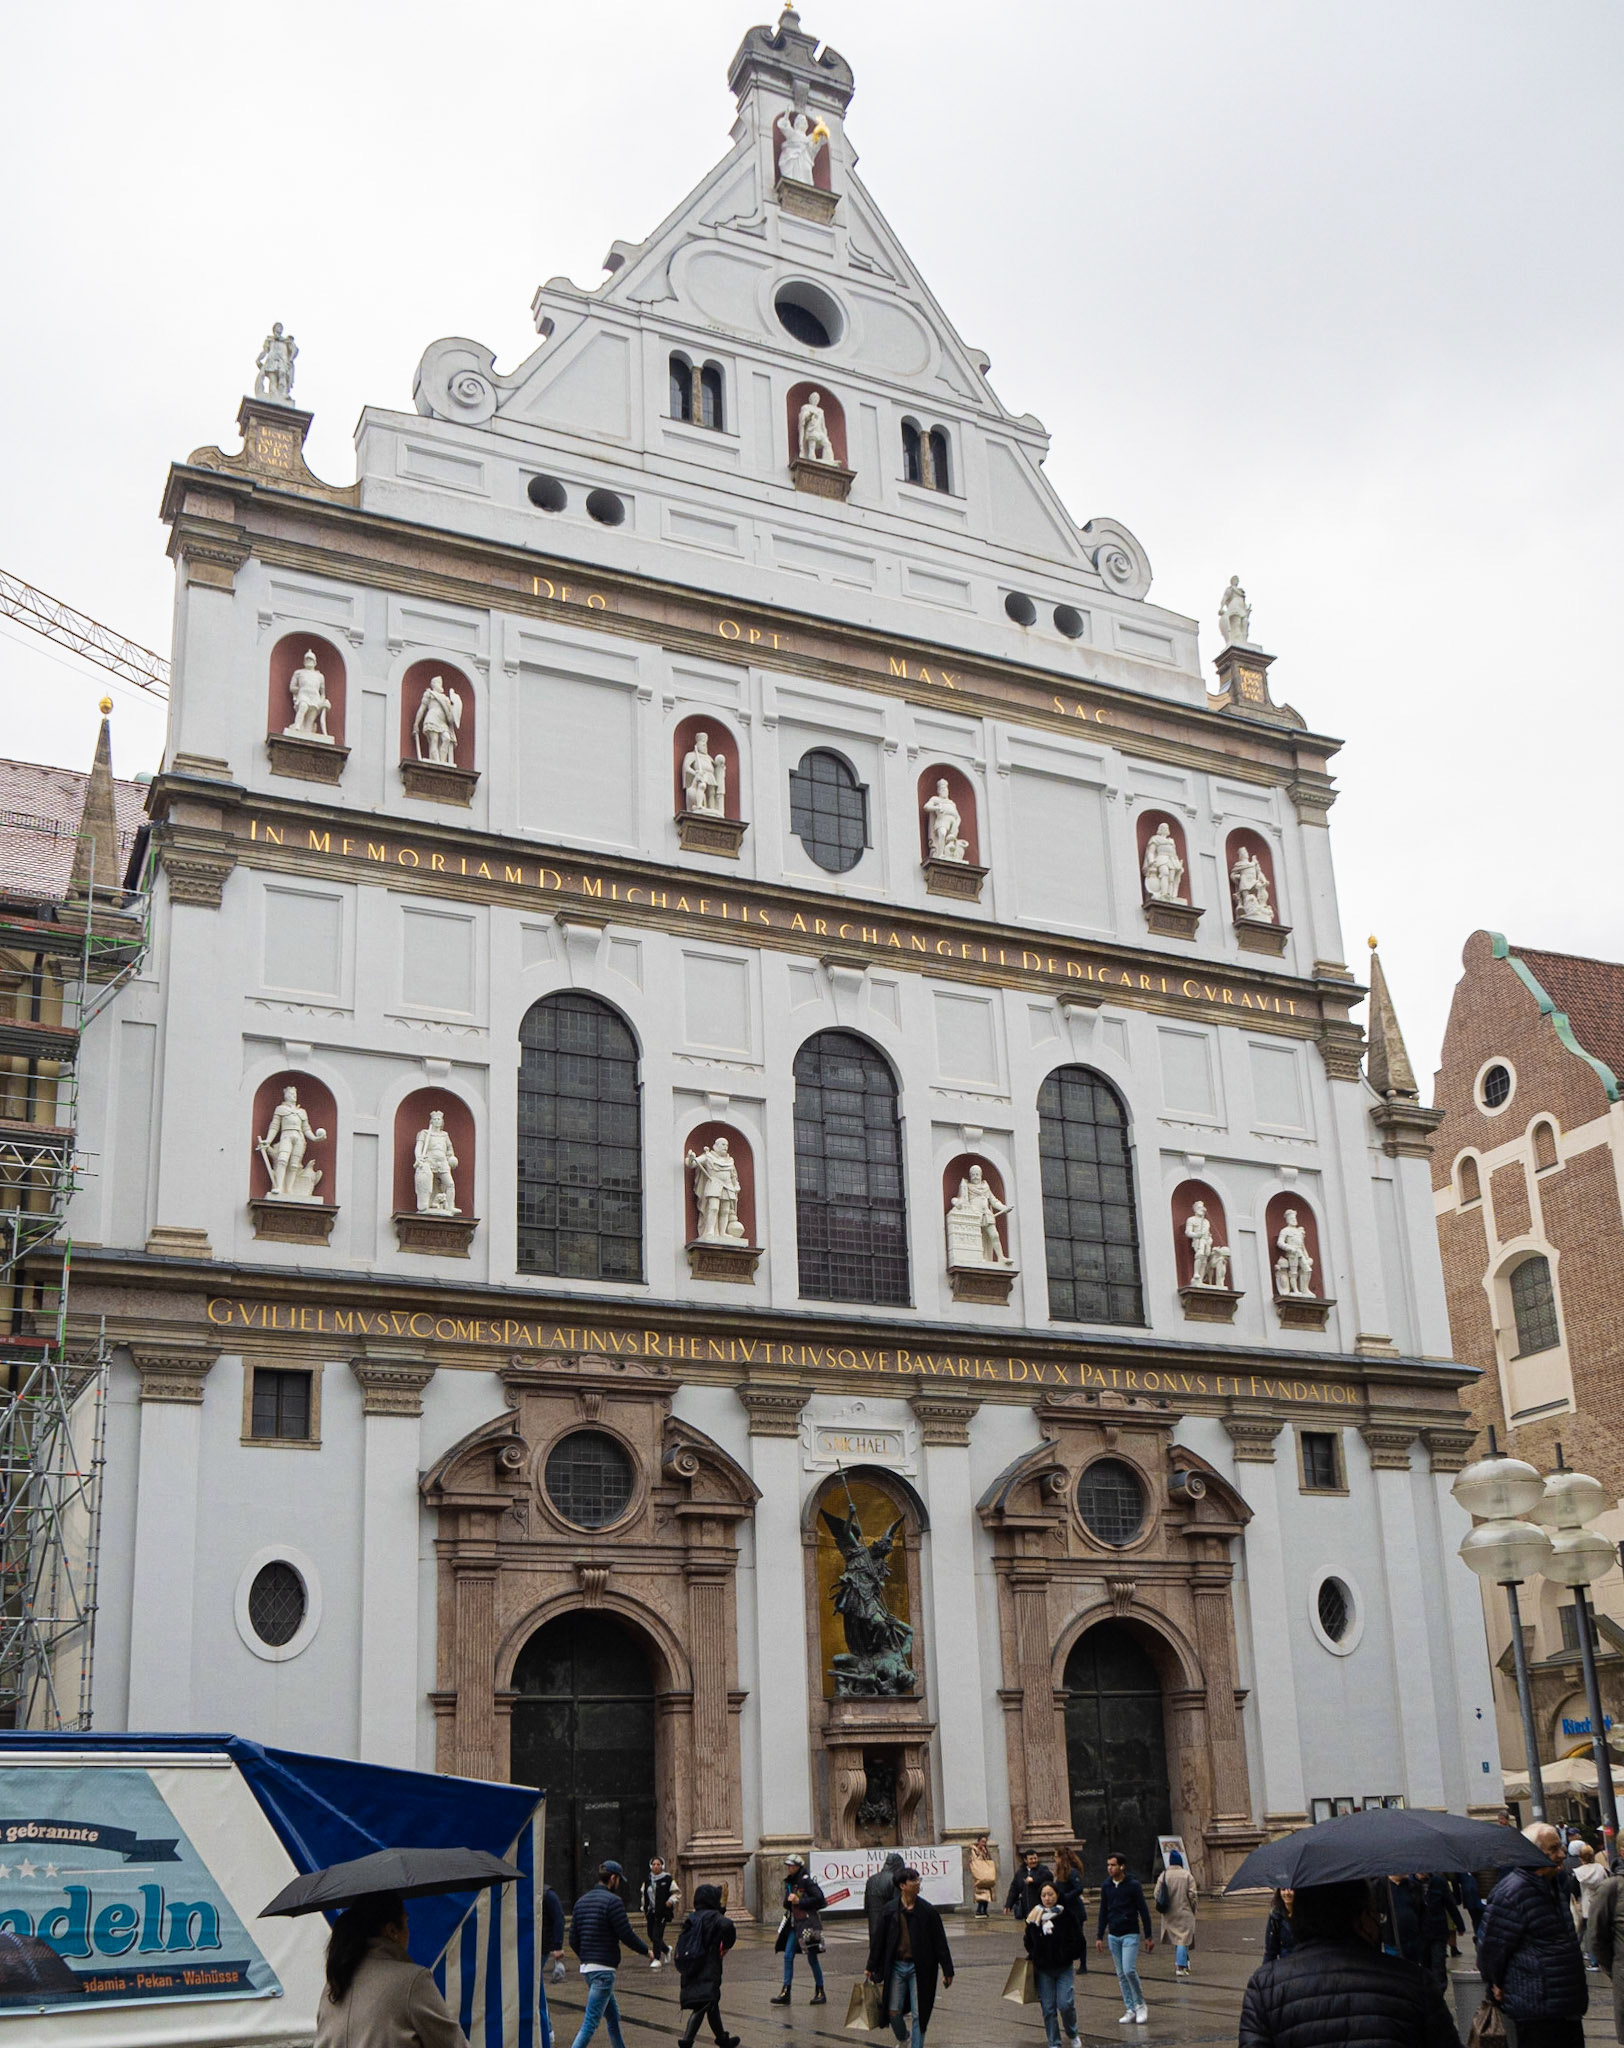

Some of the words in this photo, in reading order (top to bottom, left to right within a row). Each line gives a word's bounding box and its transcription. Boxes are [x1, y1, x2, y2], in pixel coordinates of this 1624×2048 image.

[250, 819, 284, 845] IN
[308, 829, 523, 885] MEMORIAM
[582, 875, 770, 926] MICHAELIS
[790, 912, 1006, 966] ARCHANGELI
[1022, 950, 1167, 993] DEDICARI
[206, 1298, 388, 1335] GVILIELMVS
[409, 1312, 502, 1344] COMES
[504, 1319, 638, 1354] PALATINVS
[643, 1330, 736, 1361] RHENI
[738, 1337, 889, 1372] VTRIVSQVE
[1008, 1357, 1071, 1385] DVX
[1080, 1363, 1208, 1395] PATRONVS
[1216, 1376, 1242, 1397] ET
[1250, 1375, 1359, 1404] FVNDATOR
[6, 1822, 99, 1842] gebrannte
[136, 1973, 173, 1989] Pekan
[182, 1969, 239, 1985] Walnüsse
